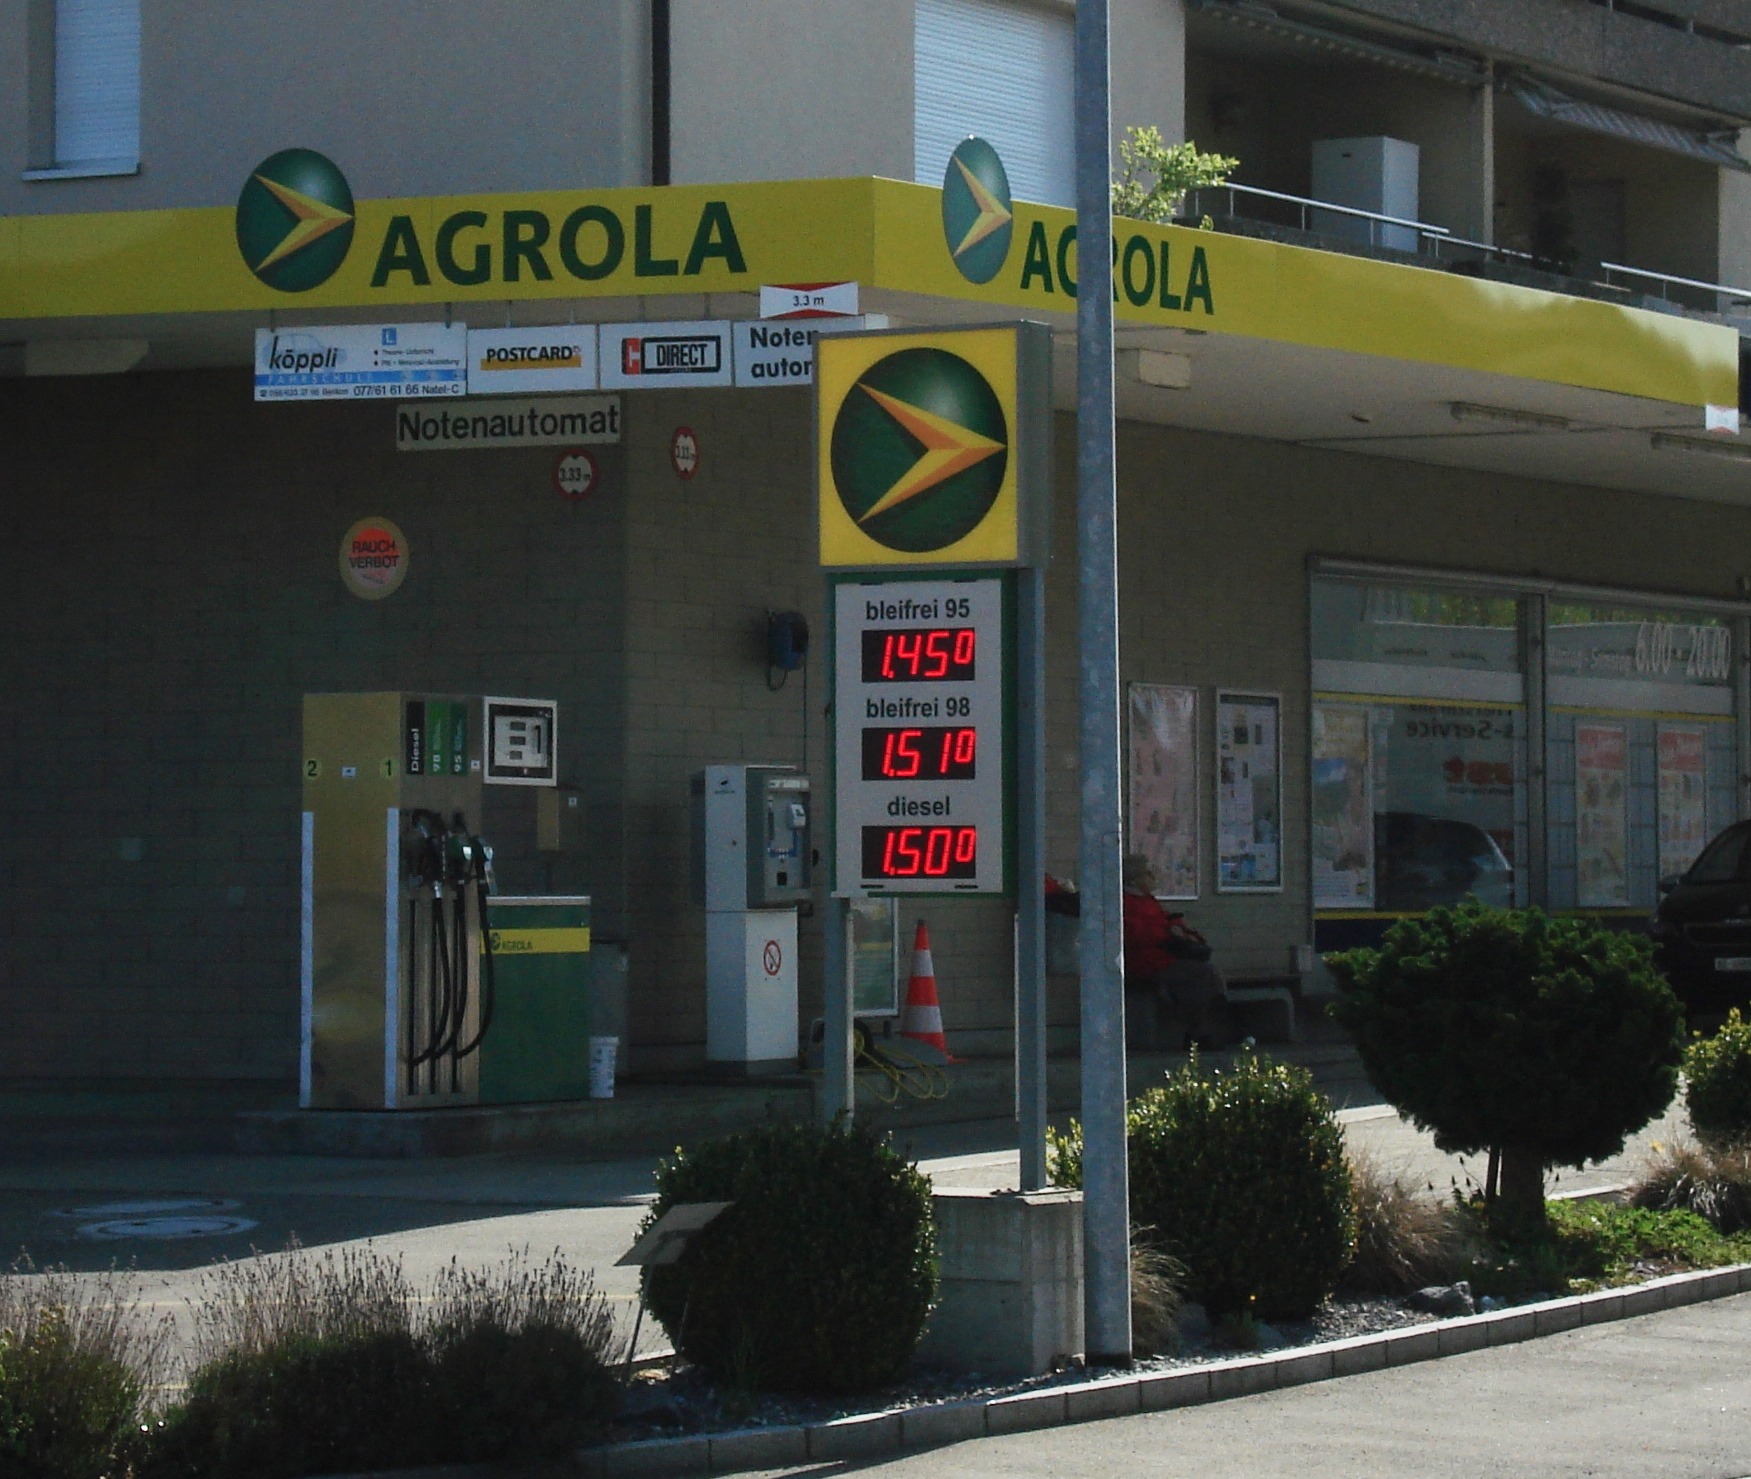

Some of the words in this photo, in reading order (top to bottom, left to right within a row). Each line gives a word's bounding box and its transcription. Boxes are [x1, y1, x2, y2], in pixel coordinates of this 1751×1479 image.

[371, 202, 748, 288] AGROLA
[793, 295, 810, 306] 3.3
[814, 296, 824, 305] m
[486, 345, 573, 363] POSTCARD
[657, 343, 708, 366] DIRECT
[354, 386, 386, 396] 077/61
[390, 385, 402, 395] 61
[405, 384, 419, 395] 66
[422, 383, 460, 393] Natel-C
[399, 405, 619, 441] Notenautomat
[560, 467, 581, 482] 3.33
[349, 556, 399, 568] VERBOT
[866, 600, 938, 620] bleifrei
[945, 599, 969, 618] 95
[882, 630, 975, 678] 1.450
[866, 698, 938, 718] bleifrei
[945, 698, 969, 717] 98
[534, 725, 541, 754] 1
[411, 728, 419, 771] Diesel
[307, 760, 317, 776] 2
[385, 760, 391, 775] 1
[454, 754, 461, 772] 95
[887, 797, 950, 816] diesel
[883, 829, 975, 876] 1.500
